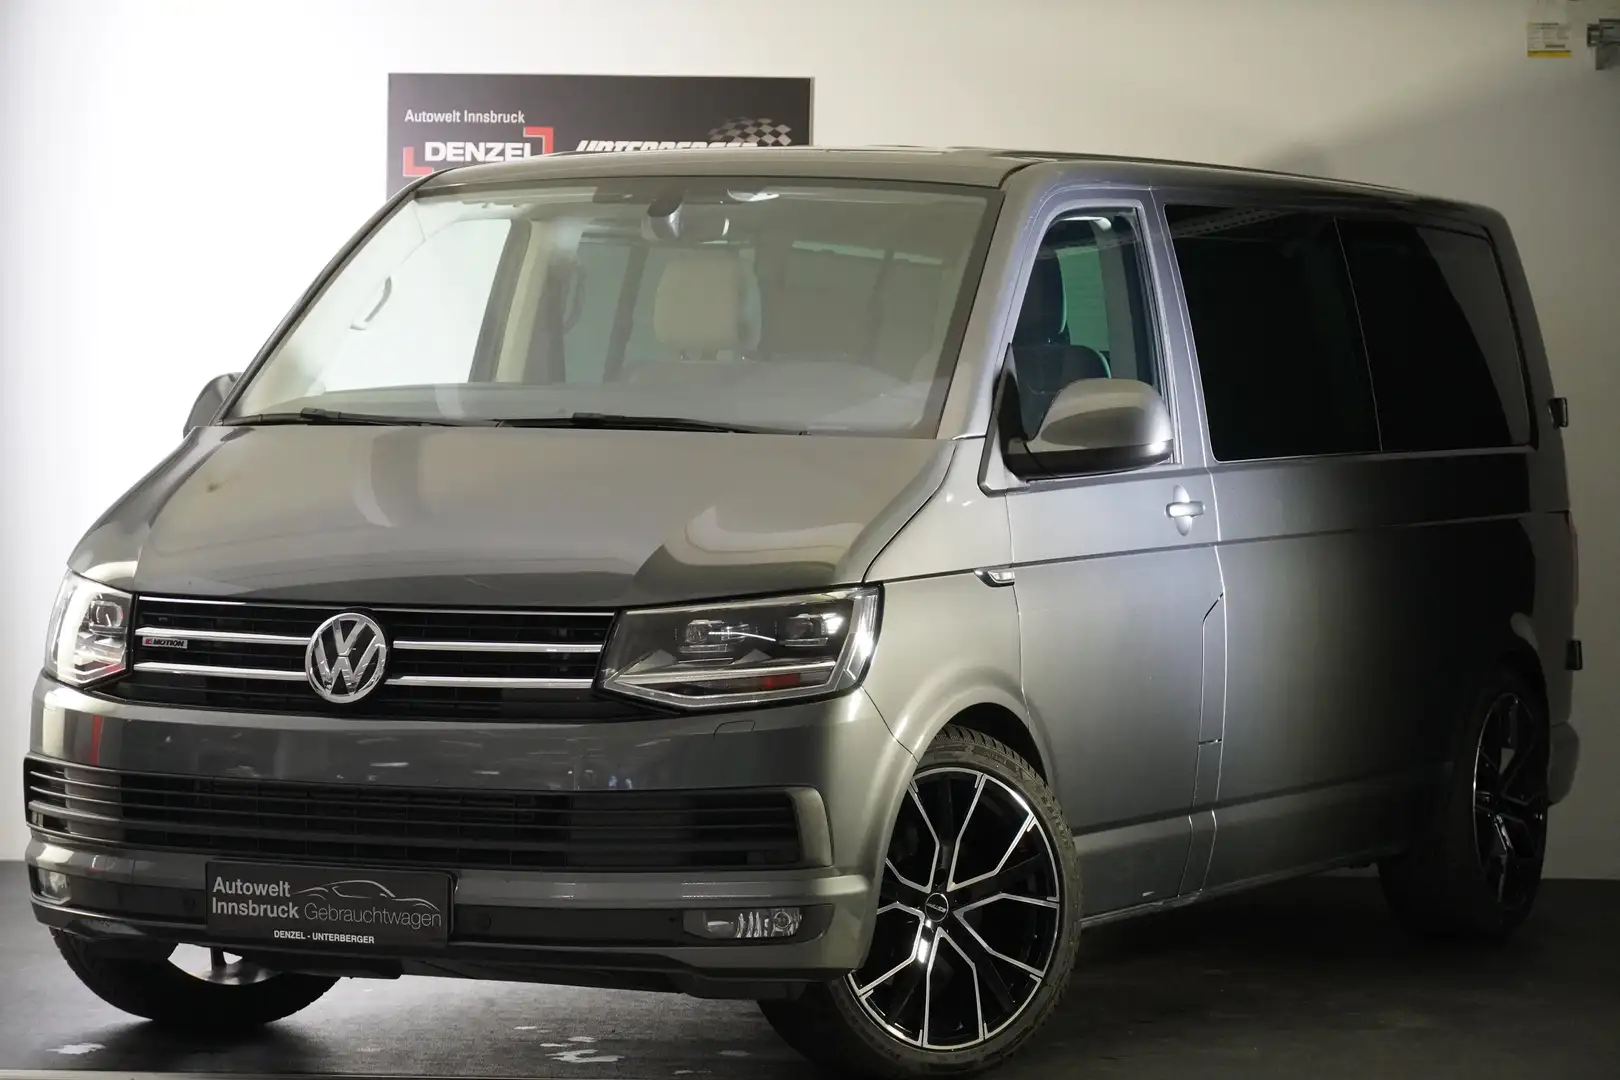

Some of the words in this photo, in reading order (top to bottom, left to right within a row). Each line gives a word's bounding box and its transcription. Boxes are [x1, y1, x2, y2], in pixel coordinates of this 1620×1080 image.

[404, 109, 462, 124] Autowelt
[464, 109, 525, 124] Innsbruck
[212, 876, 291, 897] Autowelt
[212, 897, 299, 919] Innsbruck
[304, 902, 442, 930] Gebrauchtwagen
[273, 929, 306, 940] DENZEL
[312, 931, 375, 944] UNTERBERGER
